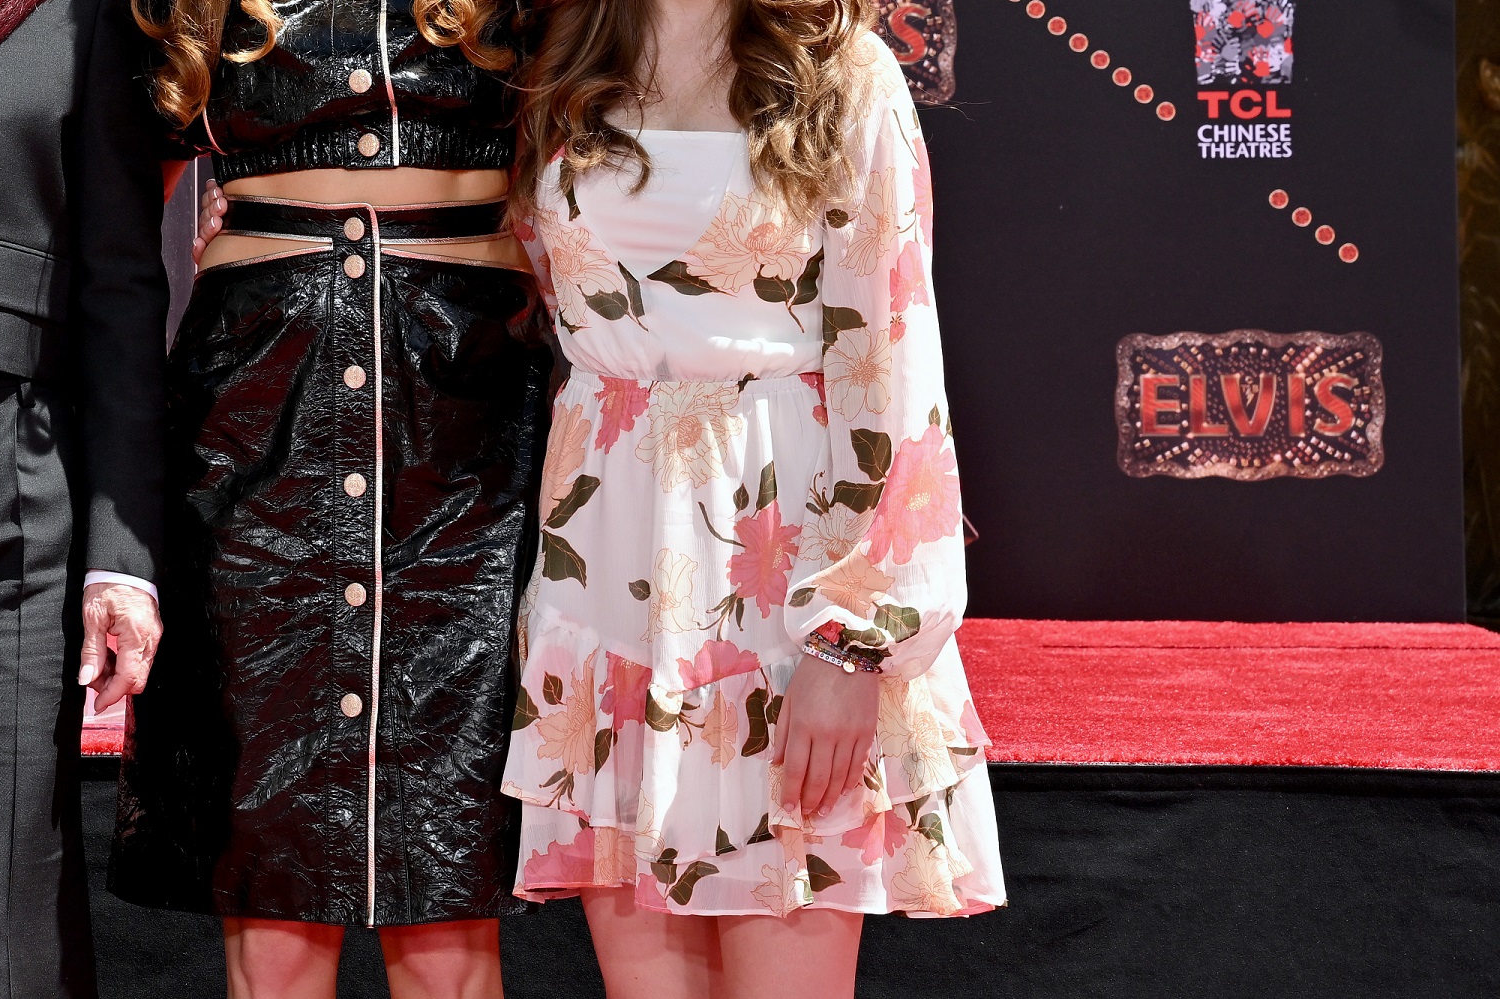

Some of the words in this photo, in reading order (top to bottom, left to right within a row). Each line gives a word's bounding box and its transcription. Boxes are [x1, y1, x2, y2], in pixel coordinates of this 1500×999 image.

[1197, 89, 1293, 120] TCL
[1197, 123, 1292, 143] CHINESE
[1197, 141, 1293, 159] THEATRES
[1139, 372, 1359, 438] ELVIS
